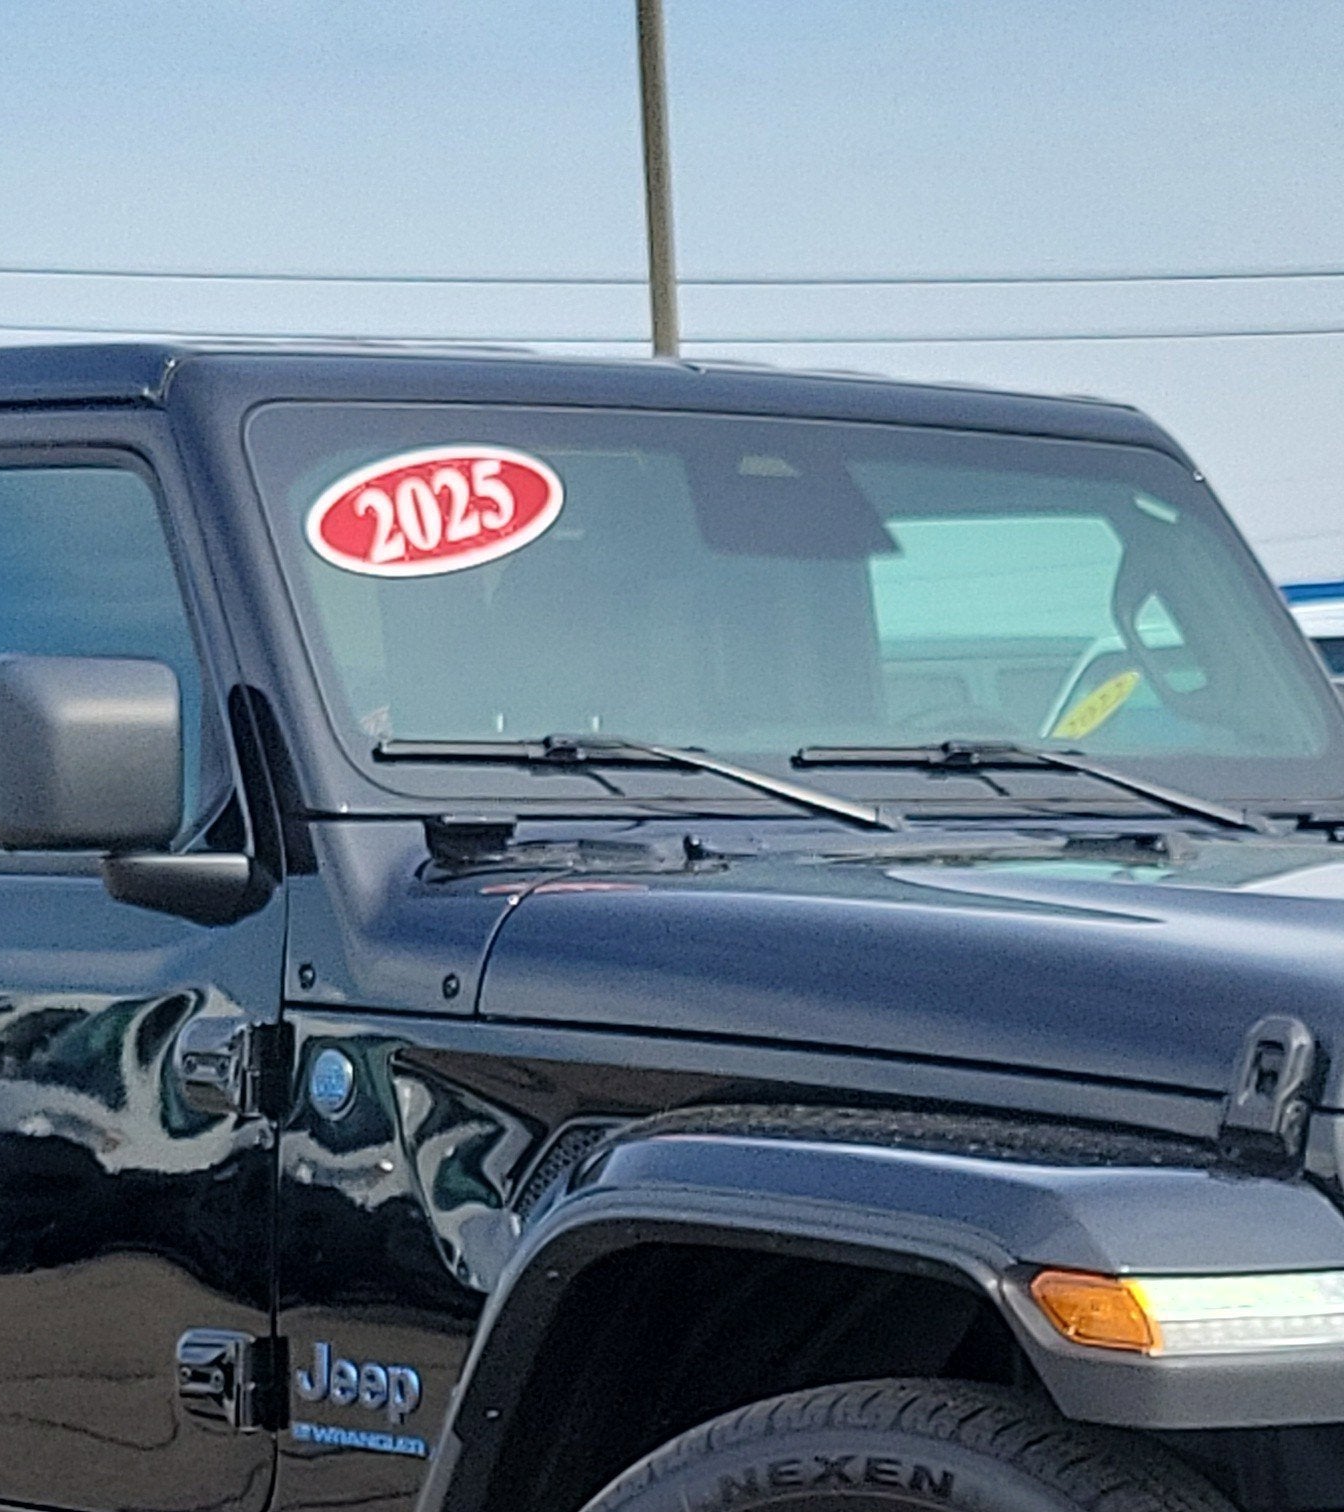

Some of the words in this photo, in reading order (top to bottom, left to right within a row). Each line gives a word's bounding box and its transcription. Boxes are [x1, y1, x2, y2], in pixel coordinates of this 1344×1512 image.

[353, 459, 516, 564] 2025
[295, 1340, 422, 1425] Jeep
[715, 1454, 957, 1502] NEXEN
